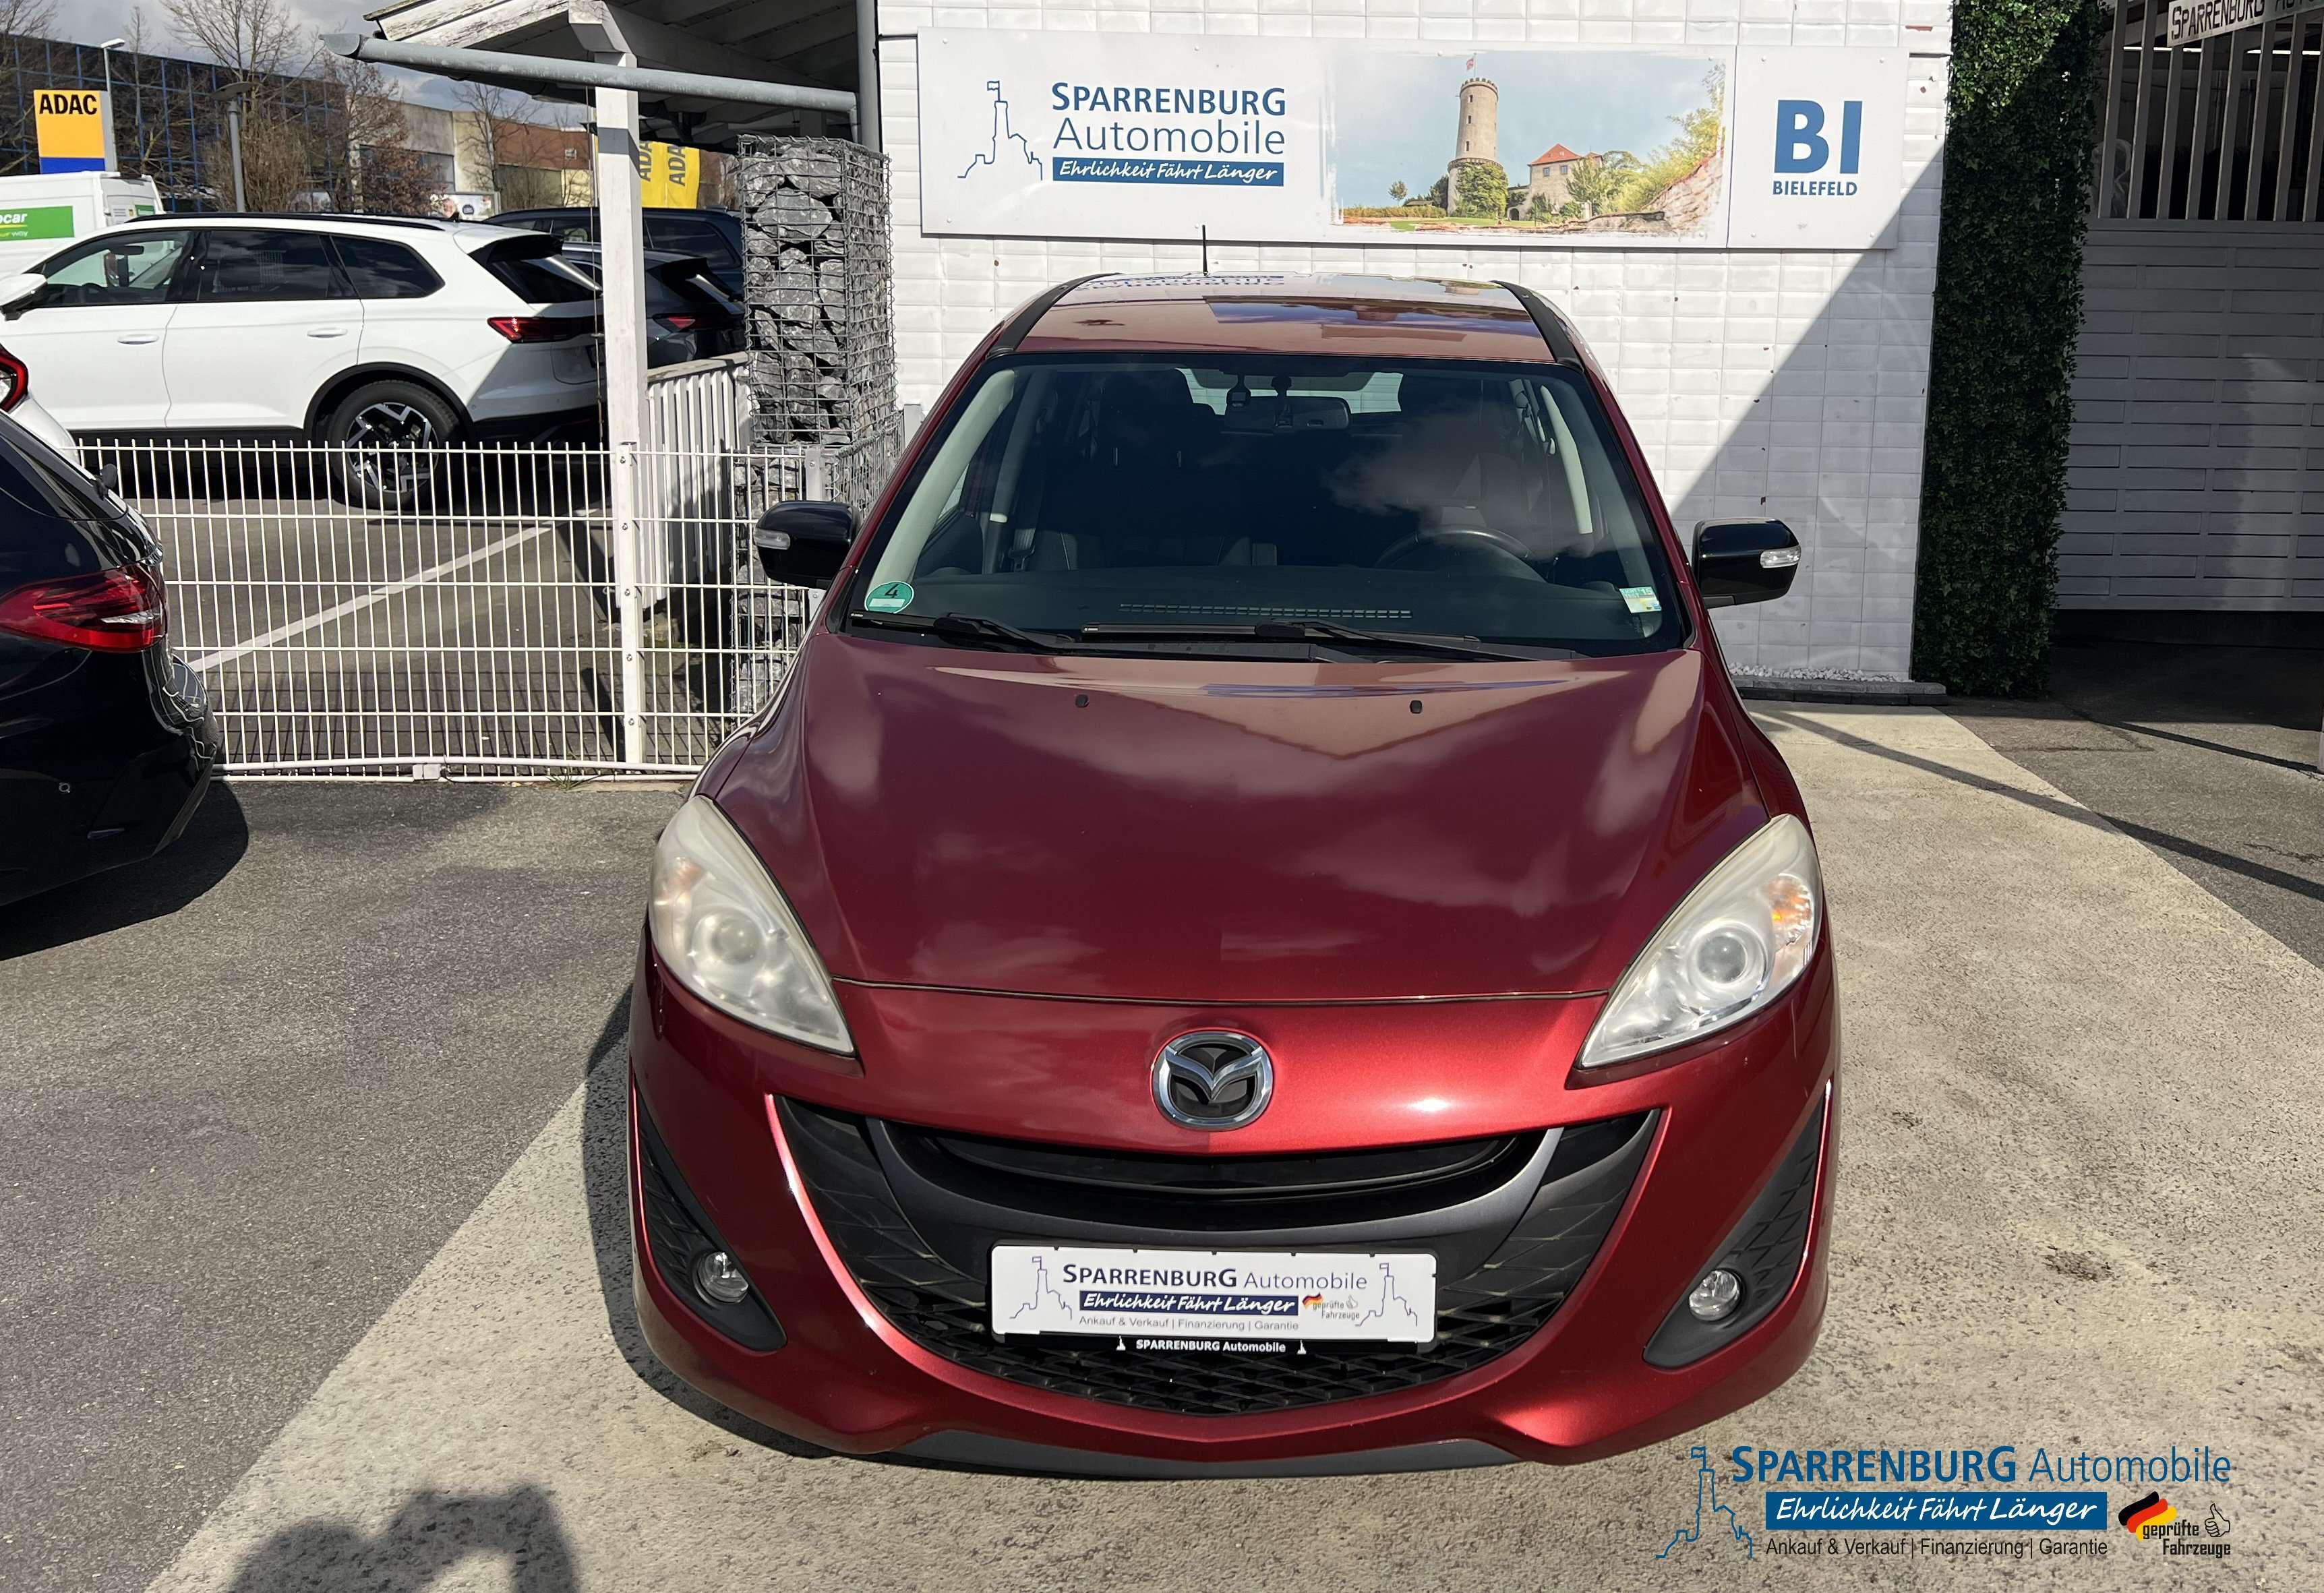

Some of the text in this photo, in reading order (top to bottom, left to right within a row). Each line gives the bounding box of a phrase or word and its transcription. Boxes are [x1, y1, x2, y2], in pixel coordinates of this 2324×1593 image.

[39, 94, 98, 115] ADAC
[1052, 82, 1286, 116] SPARRENBURG
[1053, 117, 1285, 154] Automobile
[1775, 100, 1863, 174] BI
[1059, 160, 1278, 183] Ehrlichkeit Fährt Länger
[1772, 181, 1858, 196] BIELEFELD
[885, 583, 899, 599] 4
[1063, 1263, 1367, 1289] SPARRENBURG Automobile
[1083, 1293, 1295, 1315] Ehrlichkeit Fährt Länger
[1313, 1300, 1344, 1311] geprüfte
[1079, 1315, 1116, 1326] Ankauf
[1119, 1317, 1126, 1326] &
[1129, 1317, 1169, 1327] Verkauf
[1178, 1318, 1245, 1331] Finanzierung
[1254, 1320, 1299, 1331] Garantie
[1321, 1311, 1360, 1321] Fahrzeuge
[1136, 1339, 1286, 1352] SPARRENBURG Automobile
